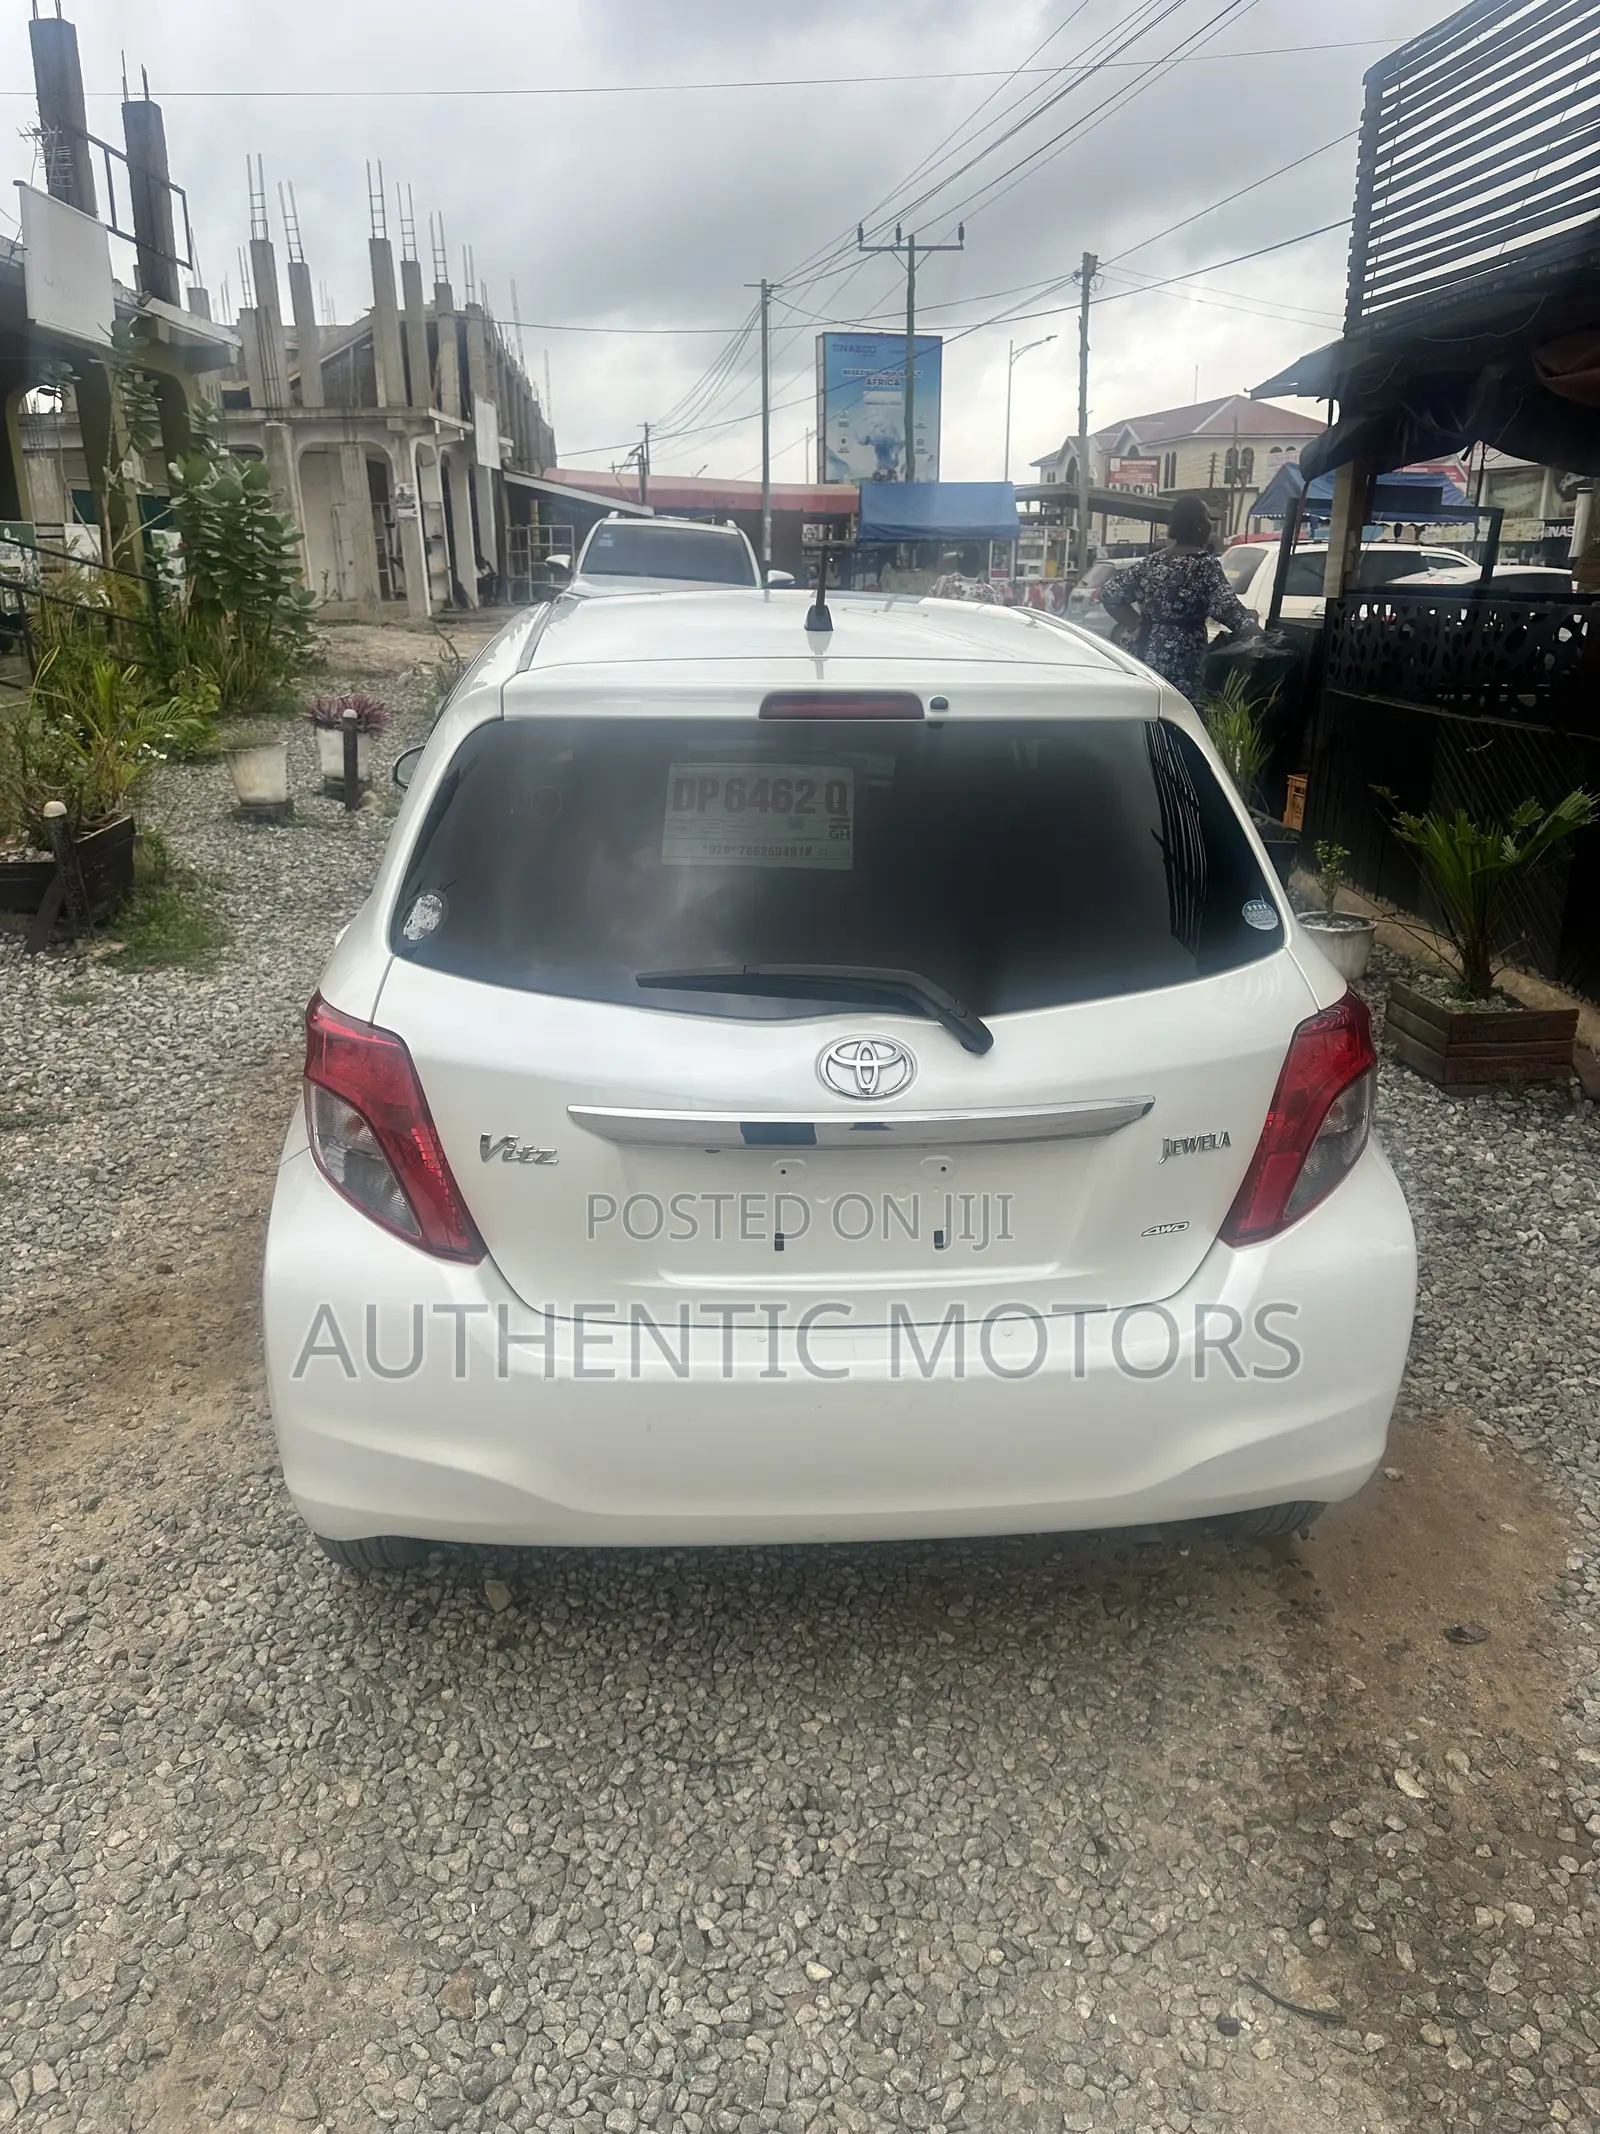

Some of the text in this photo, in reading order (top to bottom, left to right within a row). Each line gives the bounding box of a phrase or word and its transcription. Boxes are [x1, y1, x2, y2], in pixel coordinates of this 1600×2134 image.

[865, 378, 901, 388] AFRICA
[672, 777, 848, 816] DP 6462 Q
[828, 829, 850, 841] GH
[480, 1132, 559, 1164] Vitz
[1158, 1131, 1232, 1164] JEWELA
[1141, 1221, 1190, 1237] 4WD
